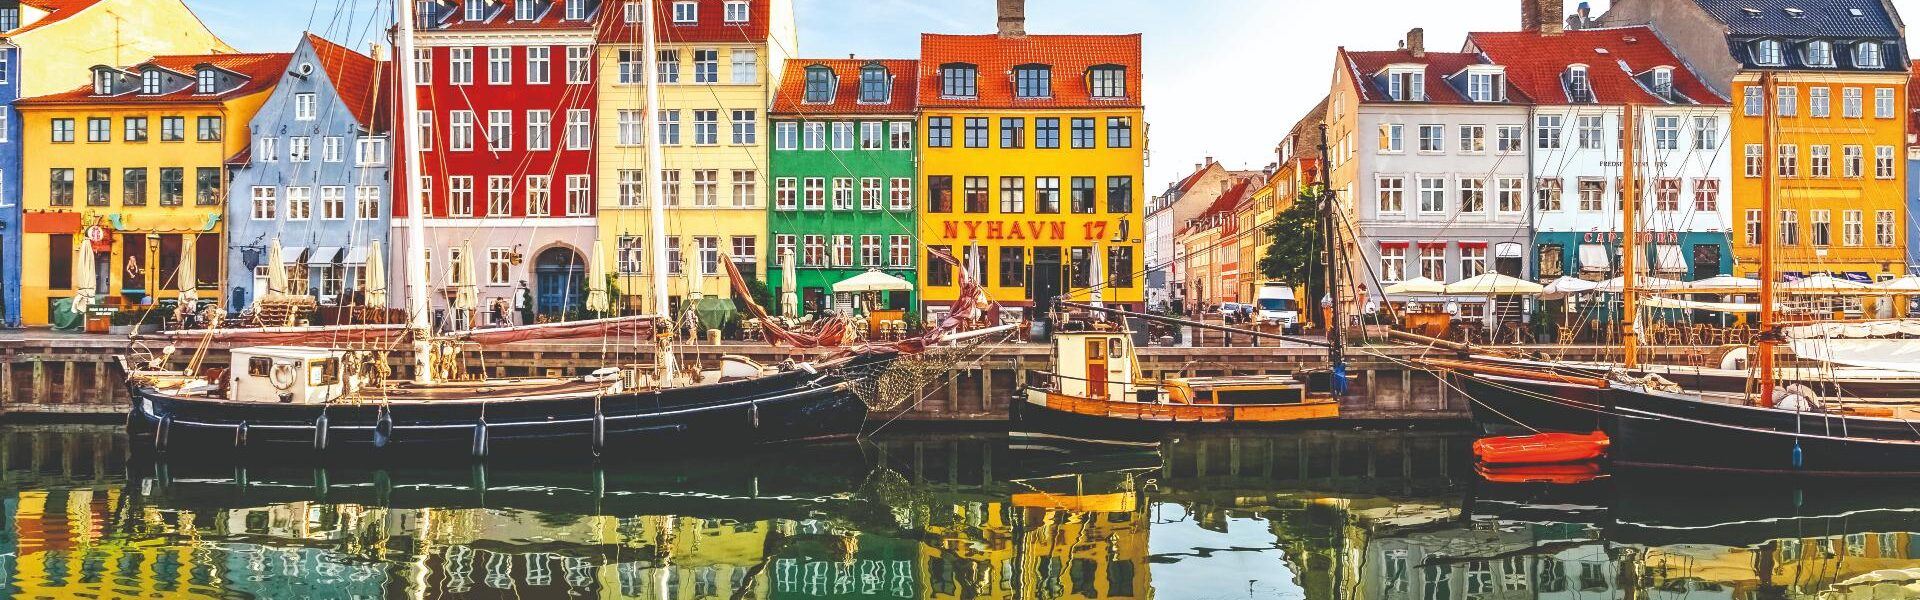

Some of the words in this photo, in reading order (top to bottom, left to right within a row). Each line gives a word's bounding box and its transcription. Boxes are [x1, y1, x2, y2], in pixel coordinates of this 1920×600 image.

[943, 220, 1066, 240] NYHAVN
[1083, 221, 1108, 241] 17
[1584, 232, 1616, 243] CAP
